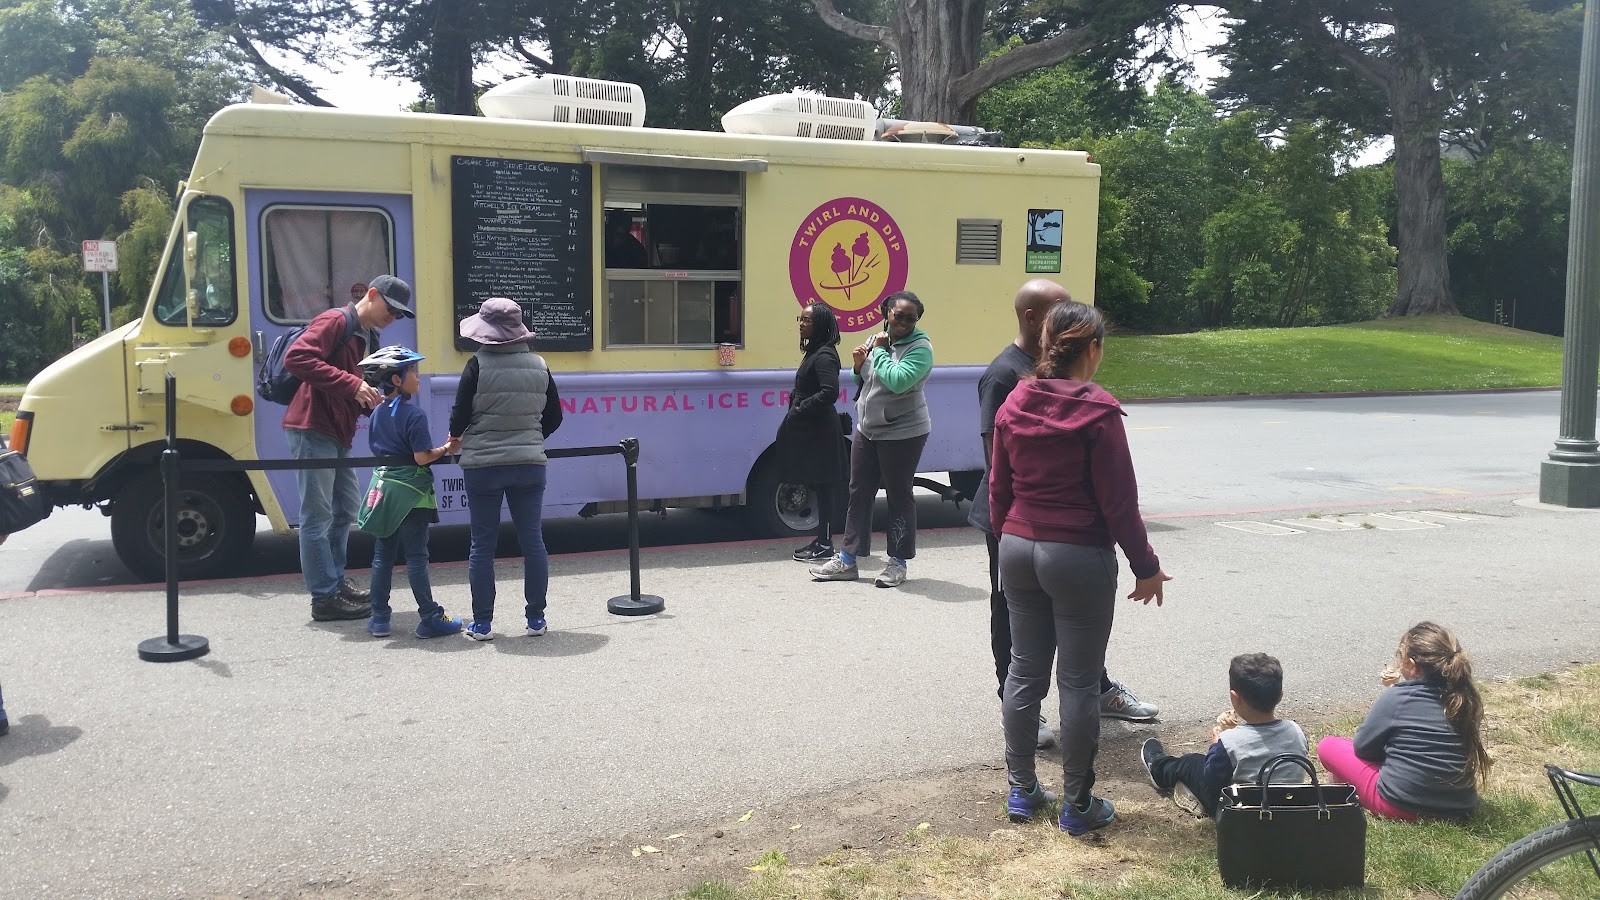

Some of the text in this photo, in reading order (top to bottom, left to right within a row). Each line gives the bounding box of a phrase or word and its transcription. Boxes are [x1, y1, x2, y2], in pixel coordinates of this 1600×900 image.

[485, 159, 499, 168] SOFT
[504, 160, 523, 169] SERVE
[524, 162, 537, 171] ICE
[538, 163, 559, 174] CREAM
[521, 186, 549, 194] CHOCOLATE
[519, 203, 541, 212] CREAM
[799, 204, 901, 251] TWIRL AND DIP
[87, 242, 99, 251] NO
[848, 304, 882, 327] SERV
[560, 394, 695, 414] NATURAL
[708, 391, 749, 410] ICE
[442, 478, 466, 492] TWIR
[442, 494, 470, 509] SF C
